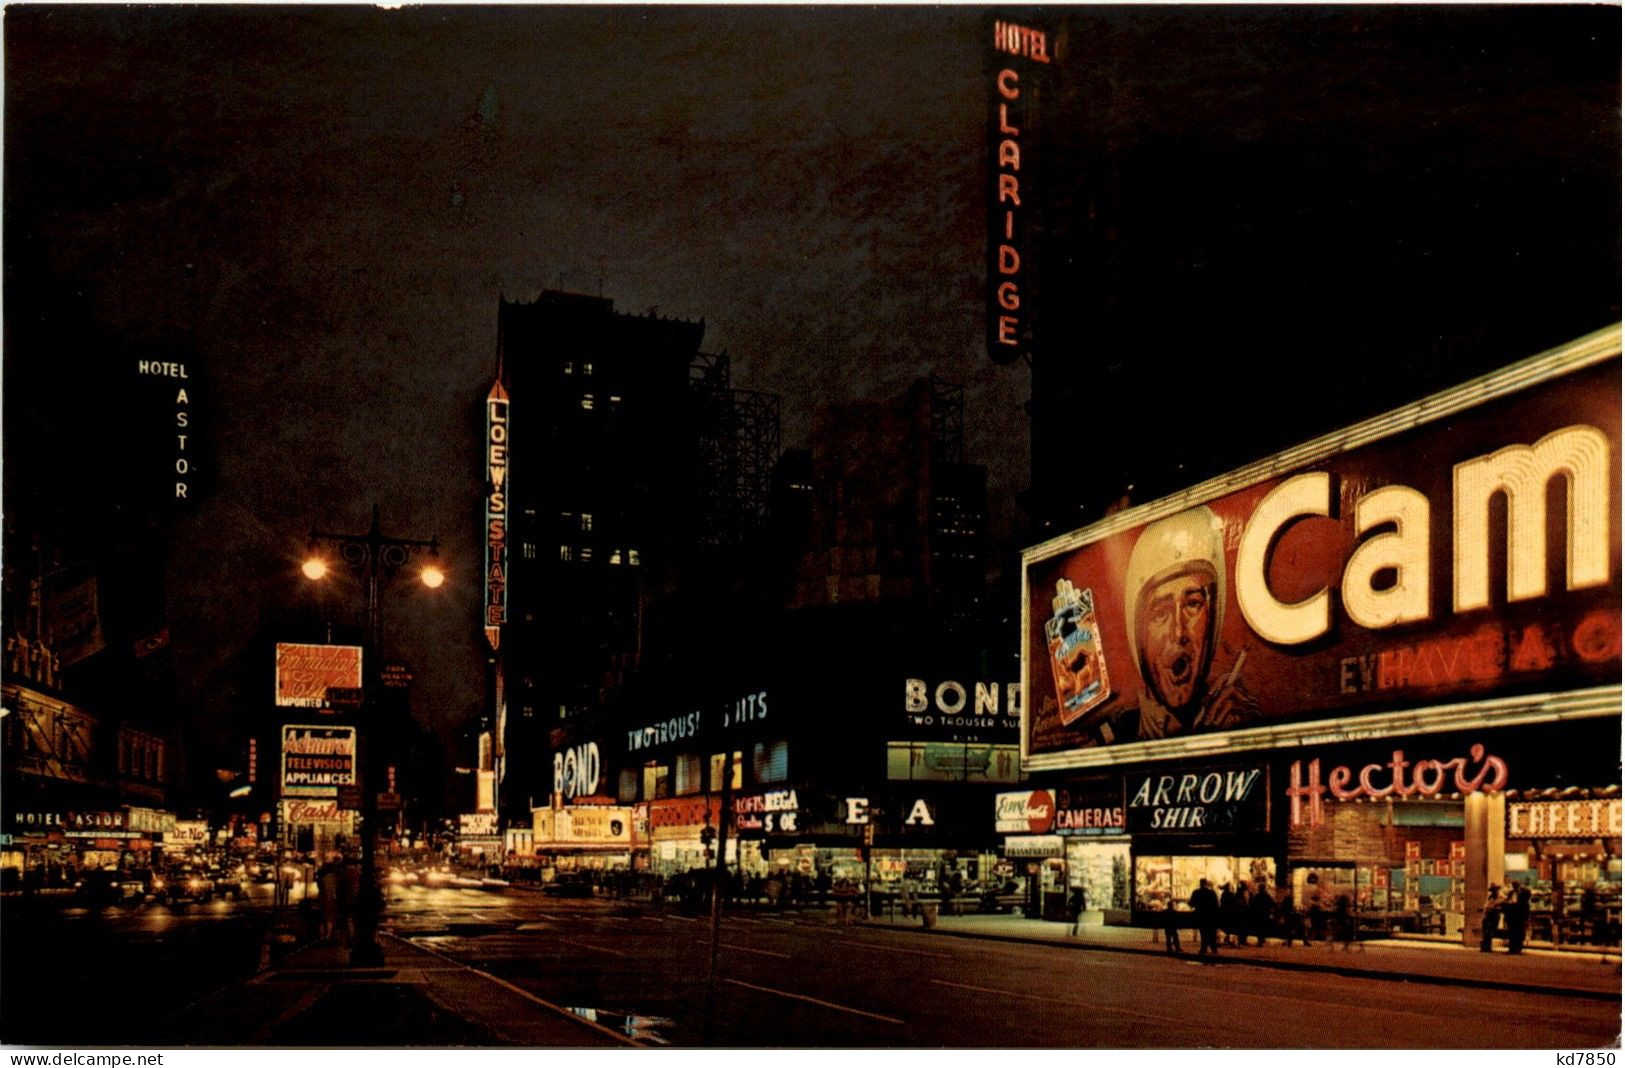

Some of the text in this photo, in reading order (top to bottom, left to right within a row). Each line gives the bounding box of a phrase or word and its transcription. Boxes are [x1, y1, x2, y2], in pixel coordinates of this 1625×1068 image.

[995, 20, 1051, 64] HOTEL
[997, 69, 1021, 346] CLARIDGE
[138, 360, 188, 378] HOTEL
[176, 388, 189, 498] ASTOR
[487, 402, 506, 625] LOEW'S STATE
[1235, 424, 1611, 646] Cam
[1510, 624, 1556, 672] A
[628, 729, 653, 751] TWO
[907, 715, 933, 725] TWO
[940, 716, 994, 727] TROUSER
[284, 730, 354, 755] Admiral
[286, 757, 352, 770] TELEVISION
[286, 772, 352, 784] APPLIANCES
[553, 741, 600, 799] BOND
[1129, 768, 1260, 808] ARROW
[1286, 743, 1508, 830] Hector's
[15, 813, 62, 825] HOTEL
[75, 814, 122, 826] ASTOR
[1057, 807, 1122, 828] CAMERAS
